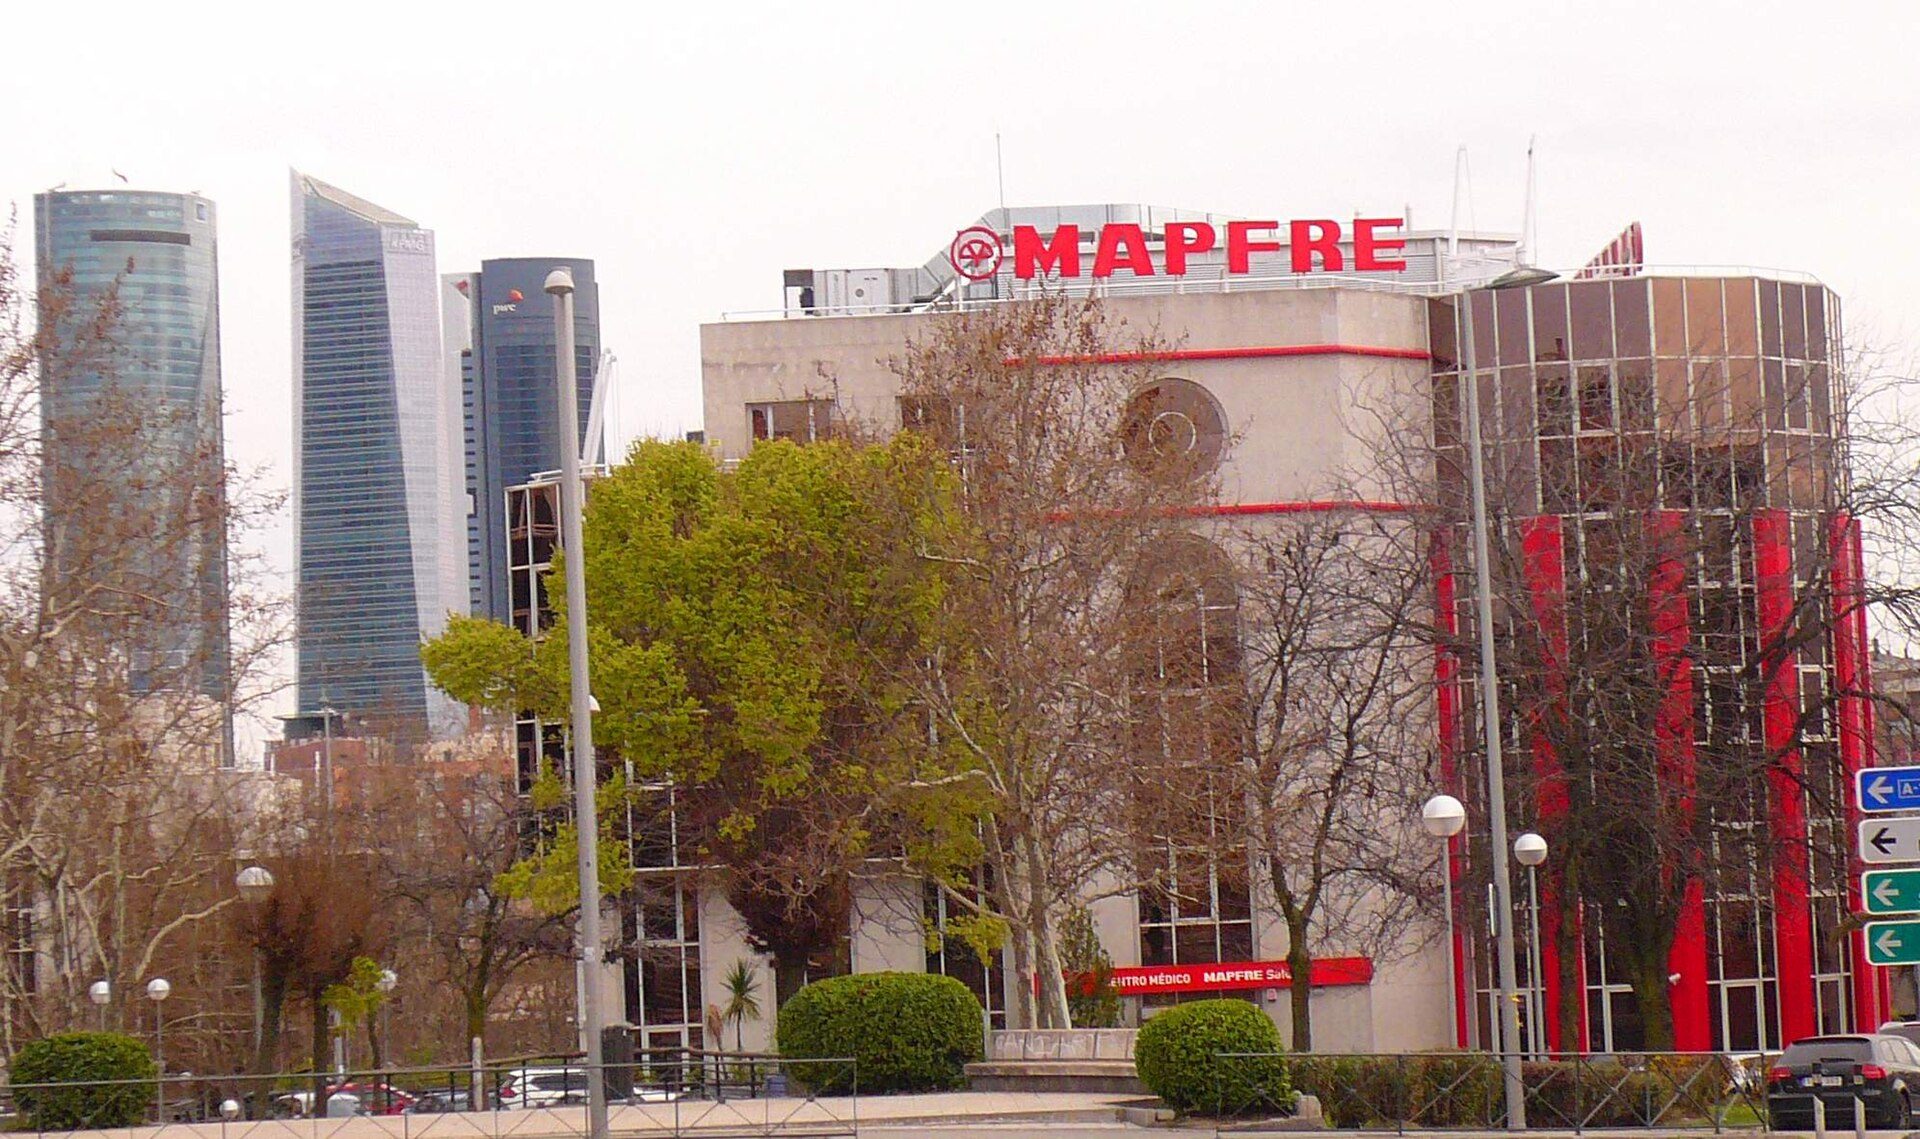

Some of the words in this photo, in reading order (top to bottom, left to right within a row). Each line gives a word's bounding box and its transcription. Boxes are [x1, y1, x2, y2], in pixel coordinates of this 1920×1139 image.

[1013, 218, 1406, 279] MAPFRE
[492, 303, 517, 315] pwc
[1902, 782, 1920, 795] A-
[1107, 975, 1147, 987] ENTRO
[1149, 972, 1191, 986] MÉDICO
[1203, 969, 1264, 983] MAPFRE
